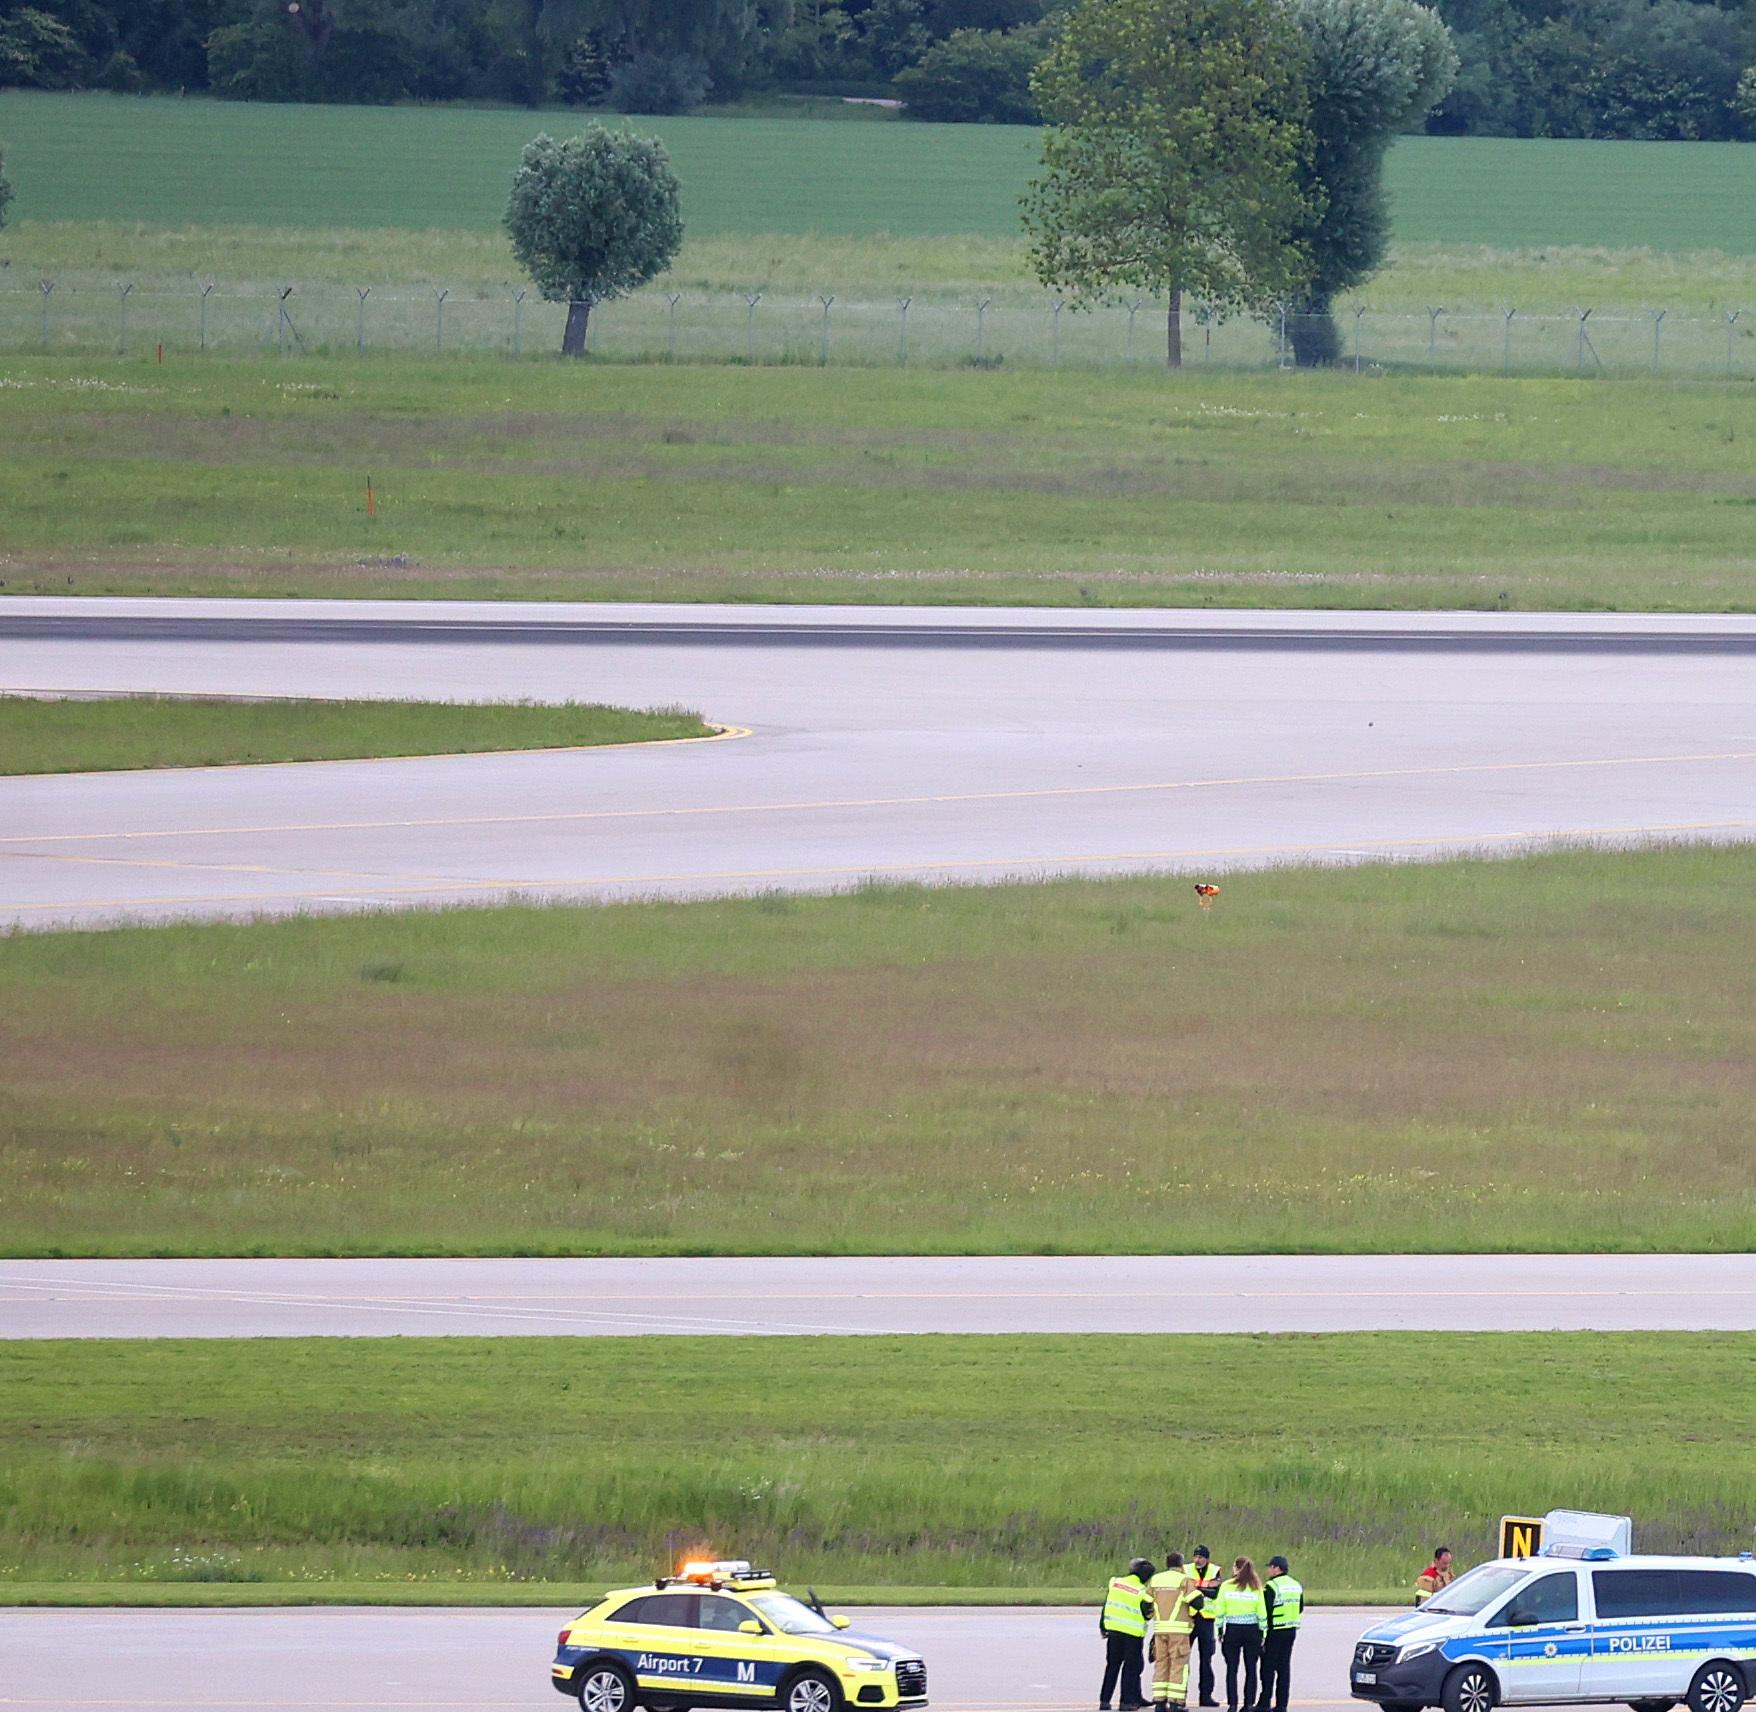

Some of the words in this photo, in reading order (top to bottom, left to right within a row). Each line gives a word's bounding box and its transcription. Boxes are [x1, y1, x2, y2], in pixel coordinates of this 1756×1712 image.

[1512, 1526, 1533, 1558] N
[1609, 1636, 1671, 1652] POLIZEI
[637, 1653, 690, 1674] Airport
[692, 1658, 704, 1673] 7
[736, 1661, 756, 1682] M
